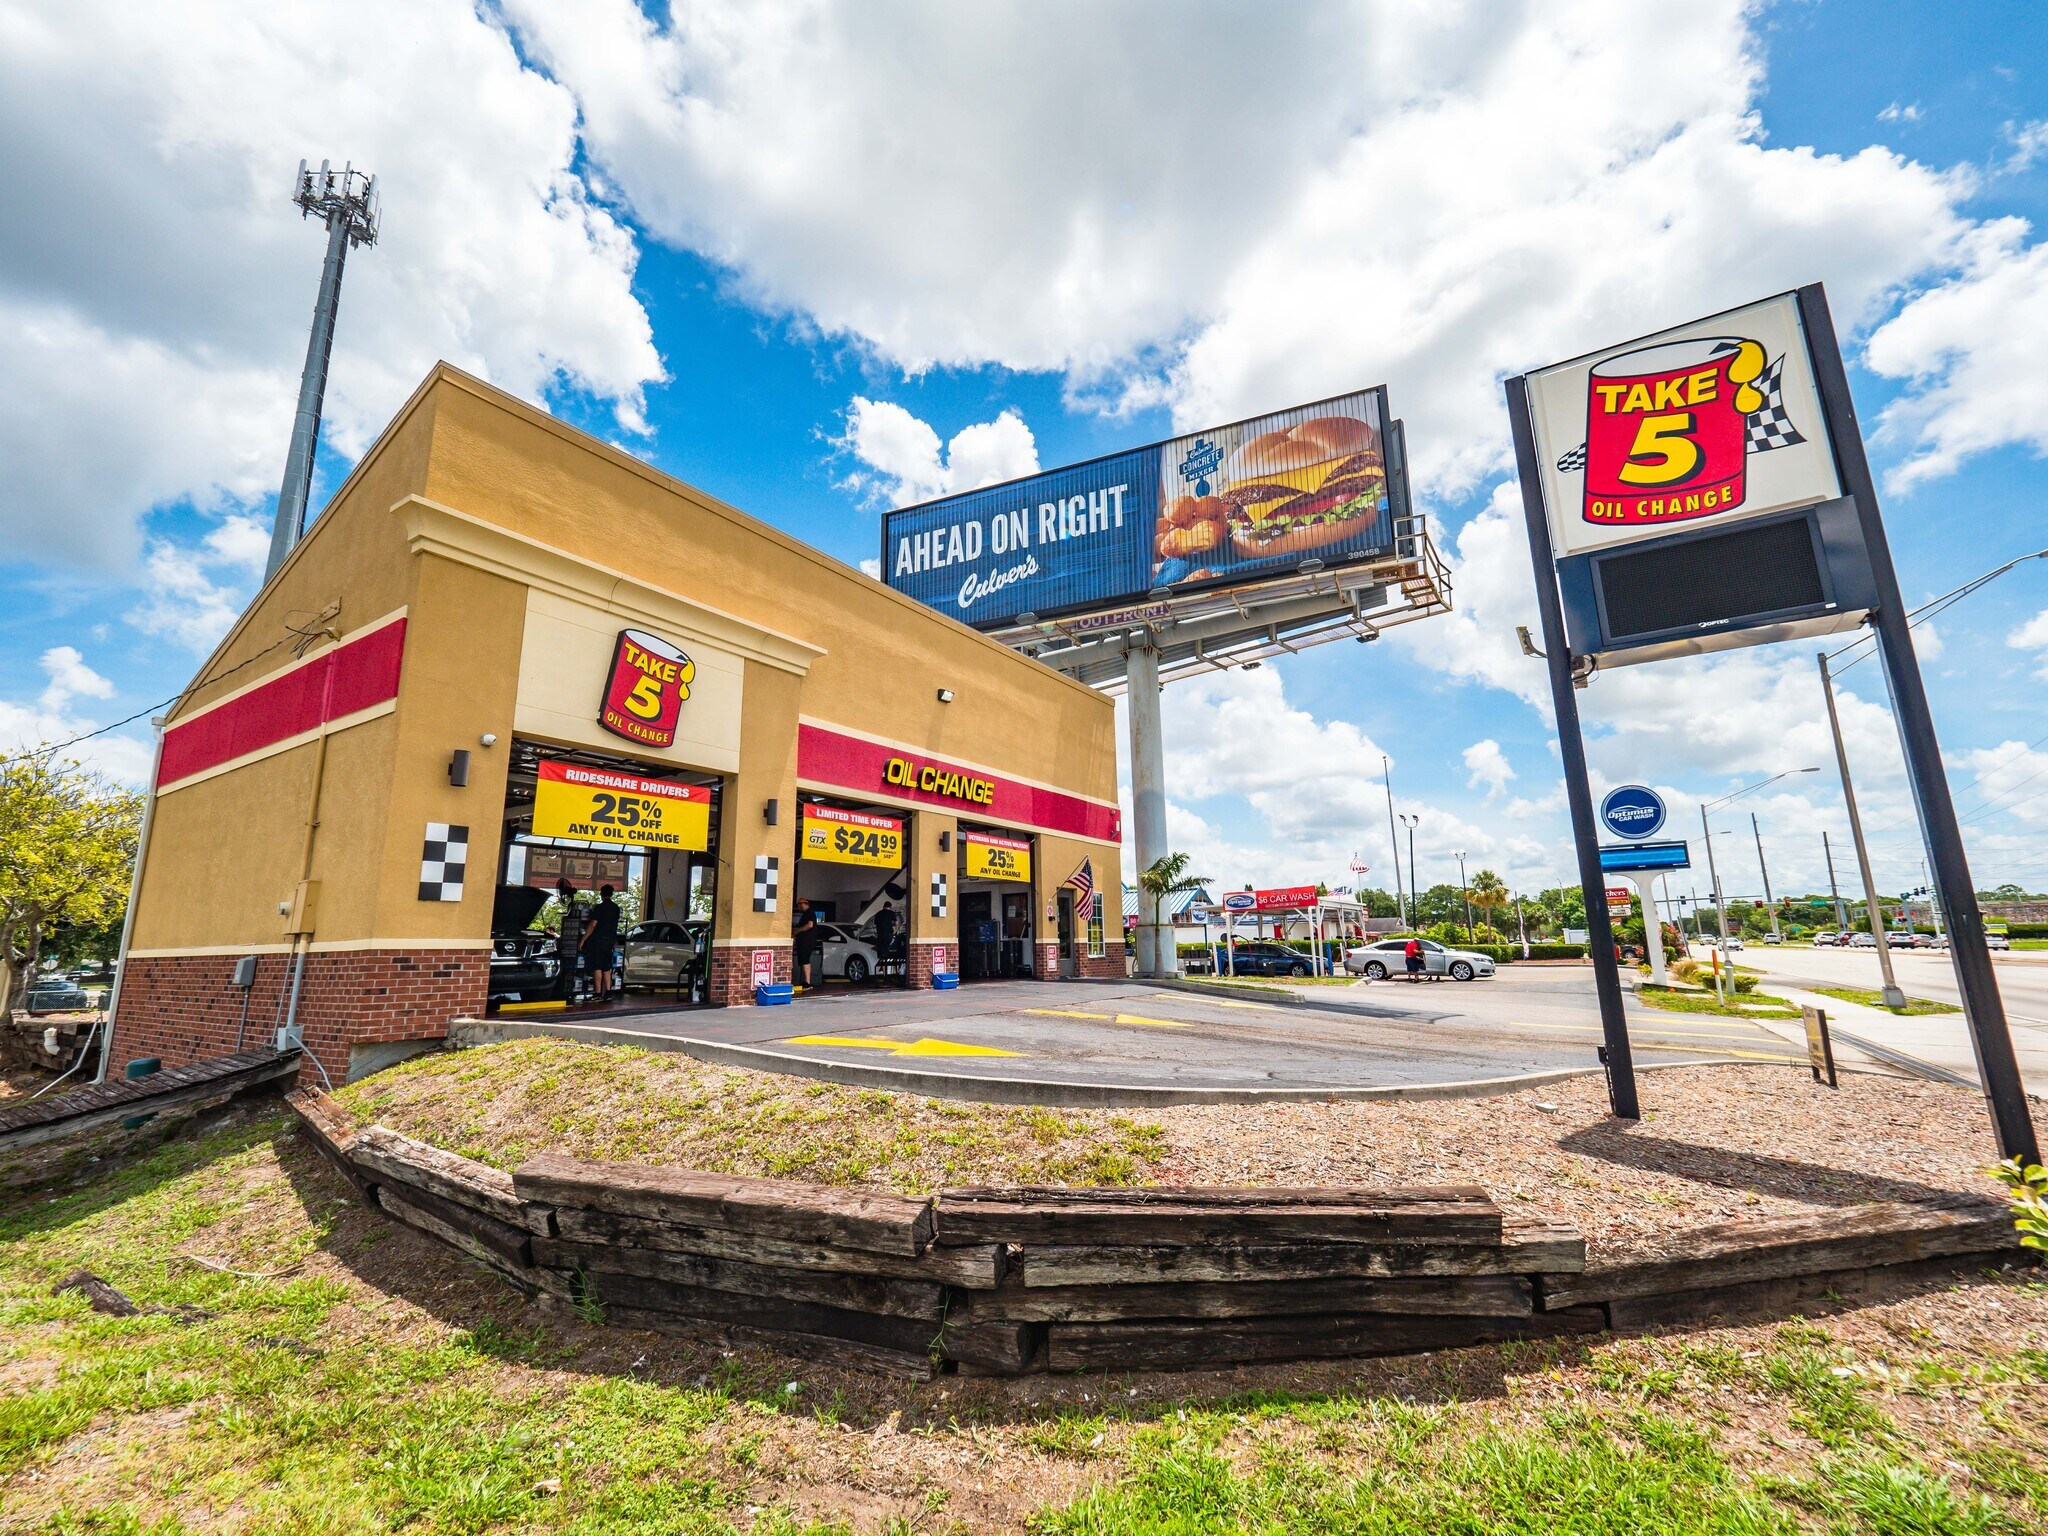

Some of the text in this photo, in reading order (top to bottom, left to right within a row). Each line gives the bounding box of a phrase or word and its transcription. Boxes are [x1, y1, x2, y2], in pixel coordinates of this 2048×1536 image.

[1596, 367, 1719, 414] TAKE
[1618, 412, 1704, 487] 5
[1182, 450, 1220, 473] CONCRETE
[1189, 466, 1214, 480] MIXER
[1592, 485, 1733, 518] OIL CHANGE
[895, 483, 1128, 577] AHEAD ON RIGHT
[1347, 548, 1380, 560] 390458
[957, 554, 1039, 608] Culver's
[624, 642, 678, 684] TAKE
[624, 674, 663, 721] 5
[607, 711, 669, 743] OIL CHANGE
[565, 769, 690, 798] RIDESHARE DRIVERS
[886, 757, 995, 805] OIL CHANGE
[640, 818, 662, 829] OFF
[816, 808, 893, 829] LIMITED TIME OFFER
[1607, 808, 1653, 819] Optimus
[568, 823, 680, 844] ANY OIL CHANGE
[809, 835, 827, 845] GTX
[980, 867, 991, 875] ANY
[1002, 870, 1021, 878] CHANGE
[1258, 892, 1316, 904] $6 CAR WASH
[755, 962, 770, 971] ONLY
[756, 954, 769, 963] EXIT
